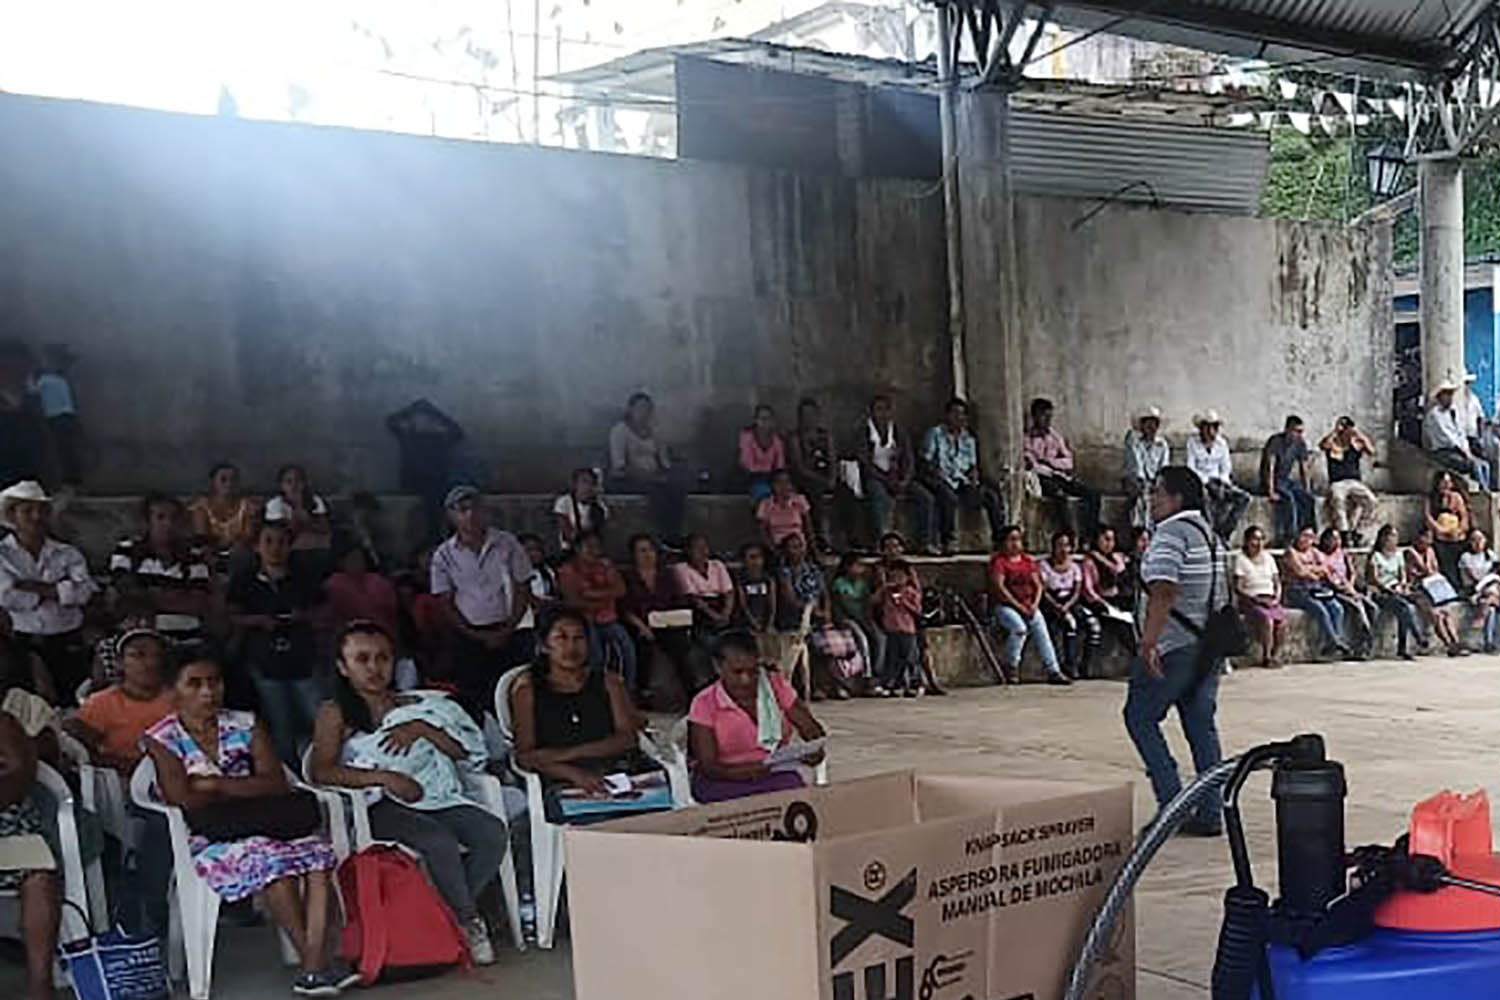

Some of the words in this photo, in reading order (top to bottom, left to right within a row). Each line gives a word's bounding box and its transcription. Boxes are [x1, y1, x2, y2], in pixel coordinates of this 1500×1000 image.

[1022, 841, 1123, 878] FUMIGADORA
[942, 888, 1005, 922] MANUAL
[1009, 883, 1033, 905] DE
[1036, 867, 1104, 896] MOCHILA
